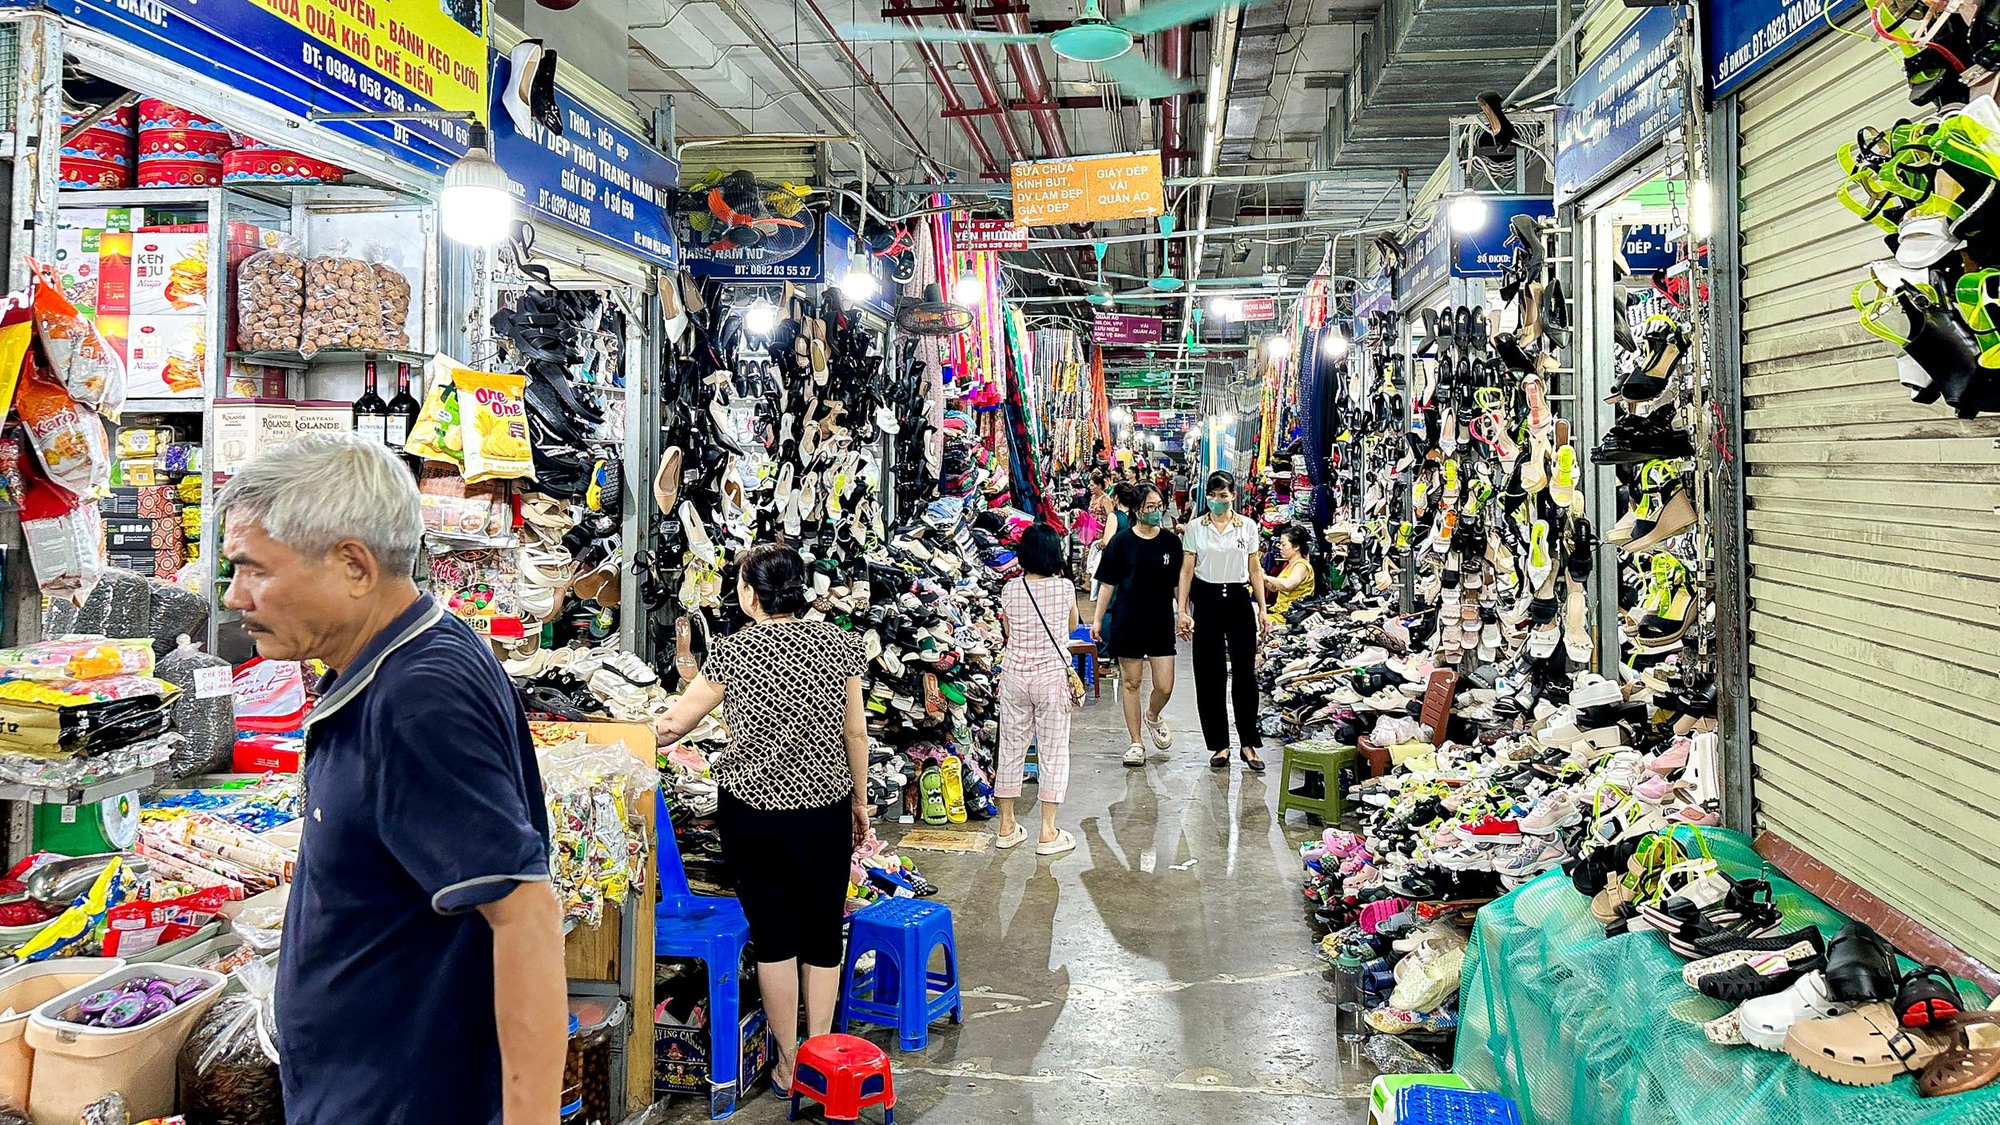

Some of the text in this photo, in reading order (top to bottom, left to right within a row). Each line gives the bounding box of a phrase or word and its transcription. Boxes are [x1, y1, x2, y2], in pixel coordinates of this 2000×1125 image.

[1787, 4, 1802, 32] 100
[305, 4, 337, 43] QUẢ
[341, 24, 370, 61] KHÔ
[374, 45, 402, 79] CHẾ
[404, 61, 434, 97] BIẾN
[389, 18, 424, 58] BÁNH
[427, 43, 450, 75] KẸO
[454, 61, 479, 94] CƯỚI
[1616, 59, 1645, 98] TRANG
[302, 42, 323, 71] ĐT:
[326, 55, 357, 89] 0984
[359, 73, 381, 101] 058
[384, 86, 404, 112] 268
[441, 120, 454, 138] 00
[568, 109, 591, 139] THOA
[597, 126, 614, 150] DÉP
[572, 144, 597, 174] THỜI
[598, 158, 631, 192] TRANG
[632, 176, 654, 203] NAM
[1125, 164, 1148, 177] DÉP
[1016, 178, 1043, 190] KÍNH
[581, 178, 597, 202] DÉP
[610, 191, 621, 214] SỐ
[1017, 193, 1032, 202] DV
[1060, 189, 1083, 201] ĐẸP
[567, 201, 580, 223] 634
[1047, 201, 1070, 213] DÉP
[1626, 239, 1652, 254] DÉP
[137, 254, 164, 264] KEN
[1476, 252, 1488, 263] SỐ
[148, 266, 163, 277] JU
[735, 265, 811, 276] ĐT: 0982 03 55 37
[475, 387, 505, 404] One
[491, 402, 520, 415] One
[262, 417, 291, 428] ROLANDE
